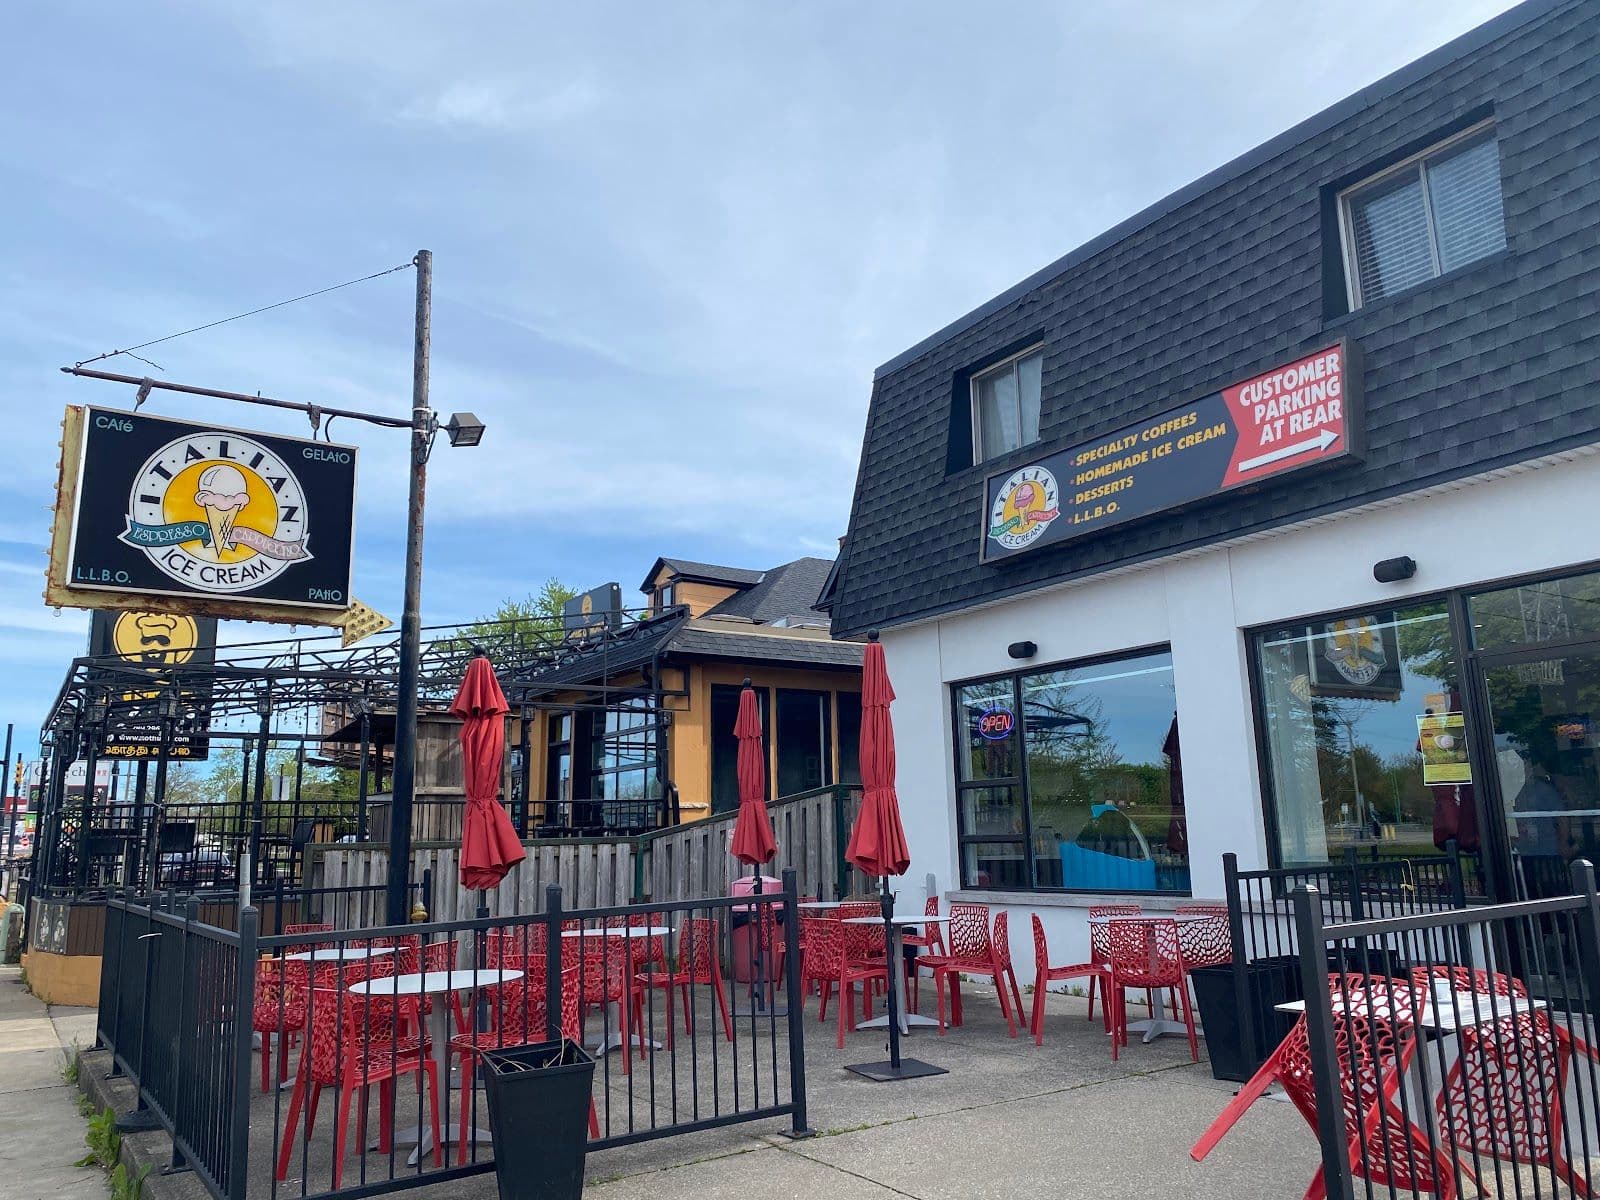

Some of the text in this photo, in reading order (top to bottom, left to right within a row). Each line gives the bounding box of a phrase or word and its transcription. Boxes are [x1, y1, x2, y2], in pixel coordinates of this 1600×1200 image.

[1240, 353, 1340, 406] CUSTOMER
[1254, 375, 1340, 425] PARKING
[1075, 411, 1198, 466] SPECIALTY COFFEES
[1260, 399, 1342, 446] AT REAR
[1075, 422, 1227, 486] HOMEMADE ICE CREAM
[1074, 475, 1134, 505] DESSERTS
[1074, 501, 1121, 525] L.L.B.O.
[132, 524, 206, 542] ESPRESSO
[1015, 523, 1044, 545] CREAM
[76, 566, 132, 584] L.L.B.O.
[161, 548, 272, 584] ICE CREAM
[980, 714, 1011, 732] OPEN
